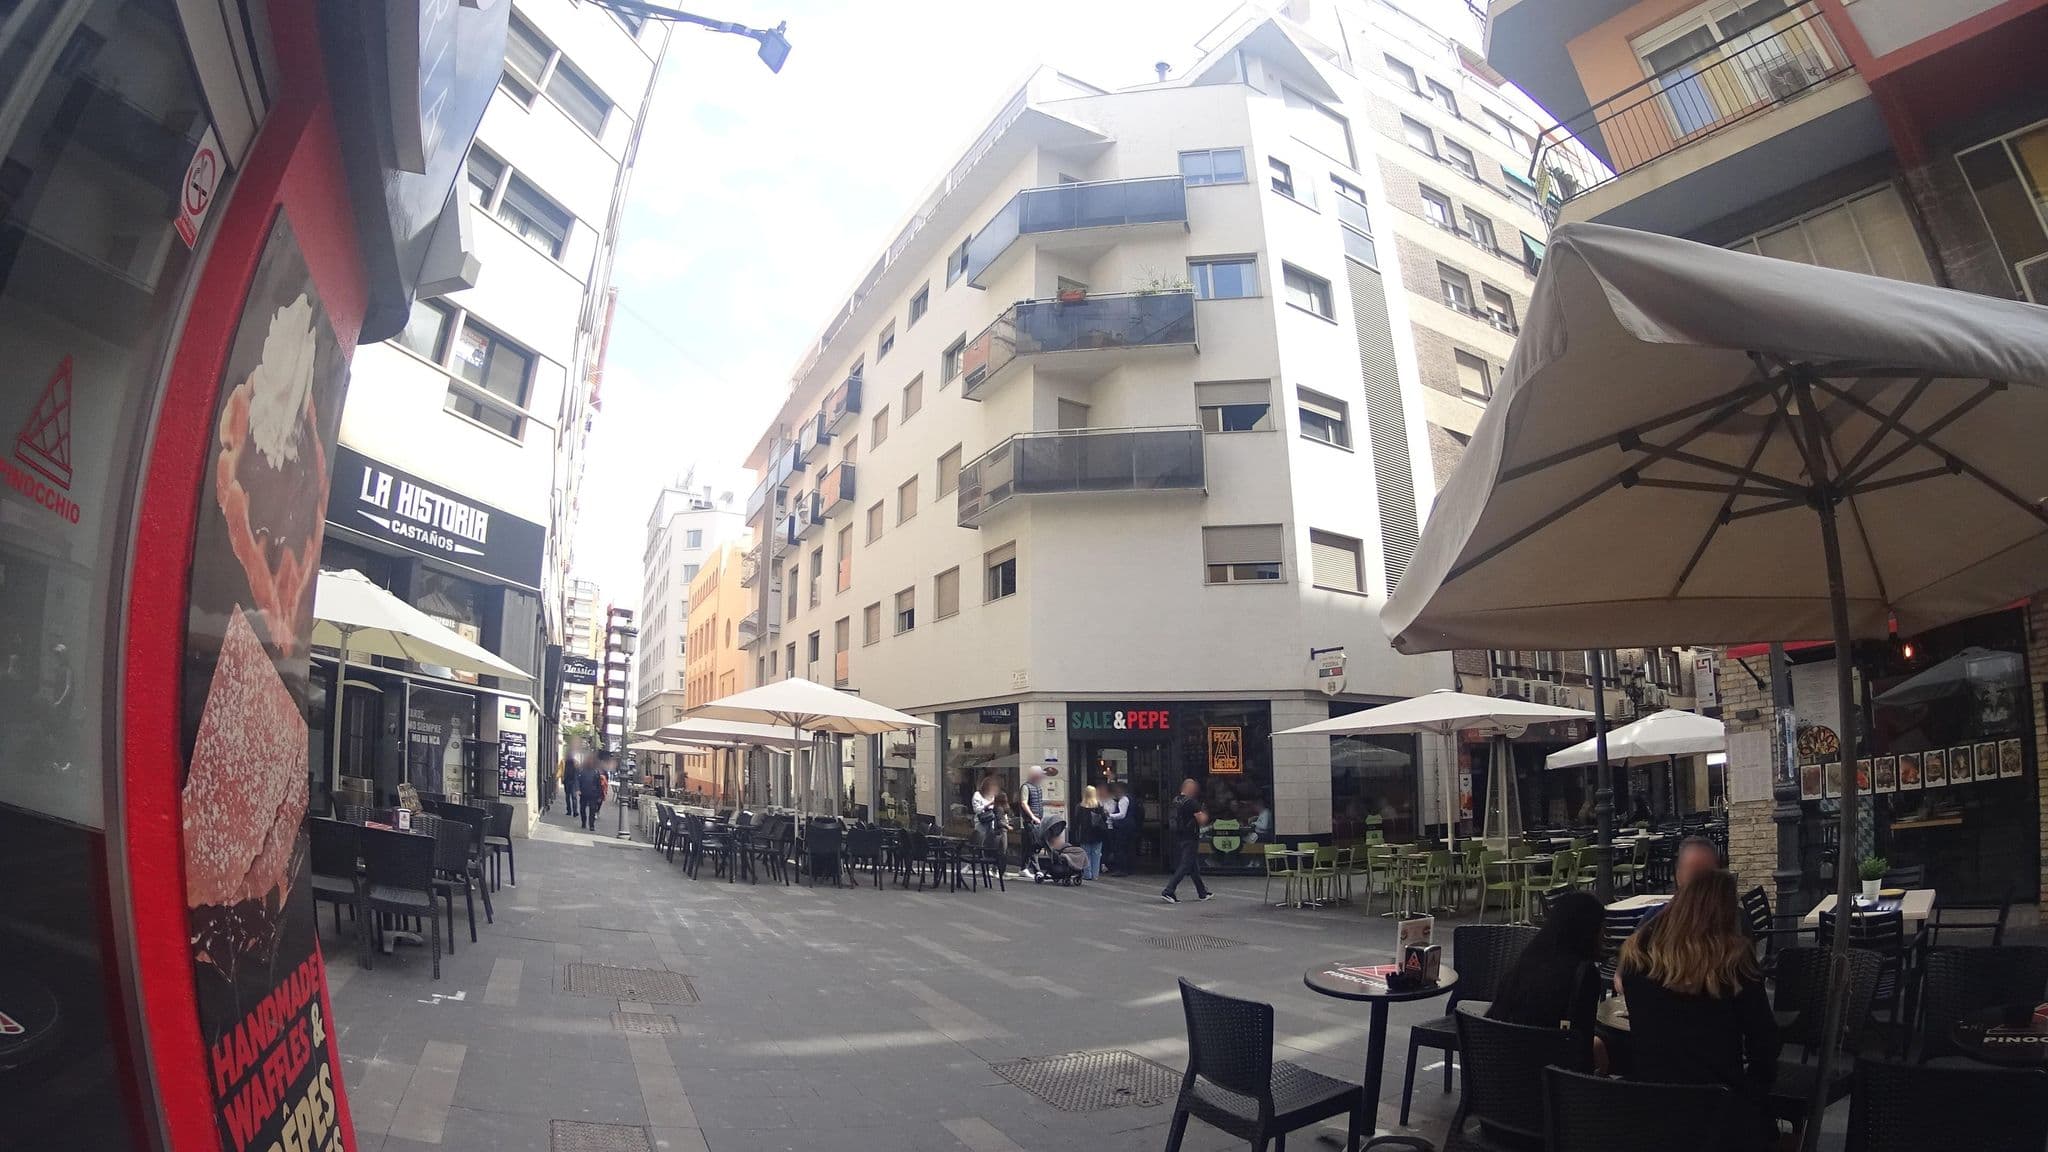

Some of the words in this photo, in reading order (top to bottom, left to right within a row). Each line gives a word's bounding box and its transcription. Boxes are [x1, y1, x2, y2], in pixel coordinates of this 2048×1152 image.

[359, 466, 394, 510] LA
[395, 480, 490, 545] HISTORIA
[391, 519, 455, 552] CASTAÑOS
[1071, 710, 1170, 730] SALE&PEPE
[1213, 731, 1237, 742] PIZZA
[1214, 740, 1238, 760] AL
[211, 951, 321, 1097] HANDMADE
[223, 1016, 312, 1152] WAFFLES
[267, 1062, 336, 1152] ÊPES
